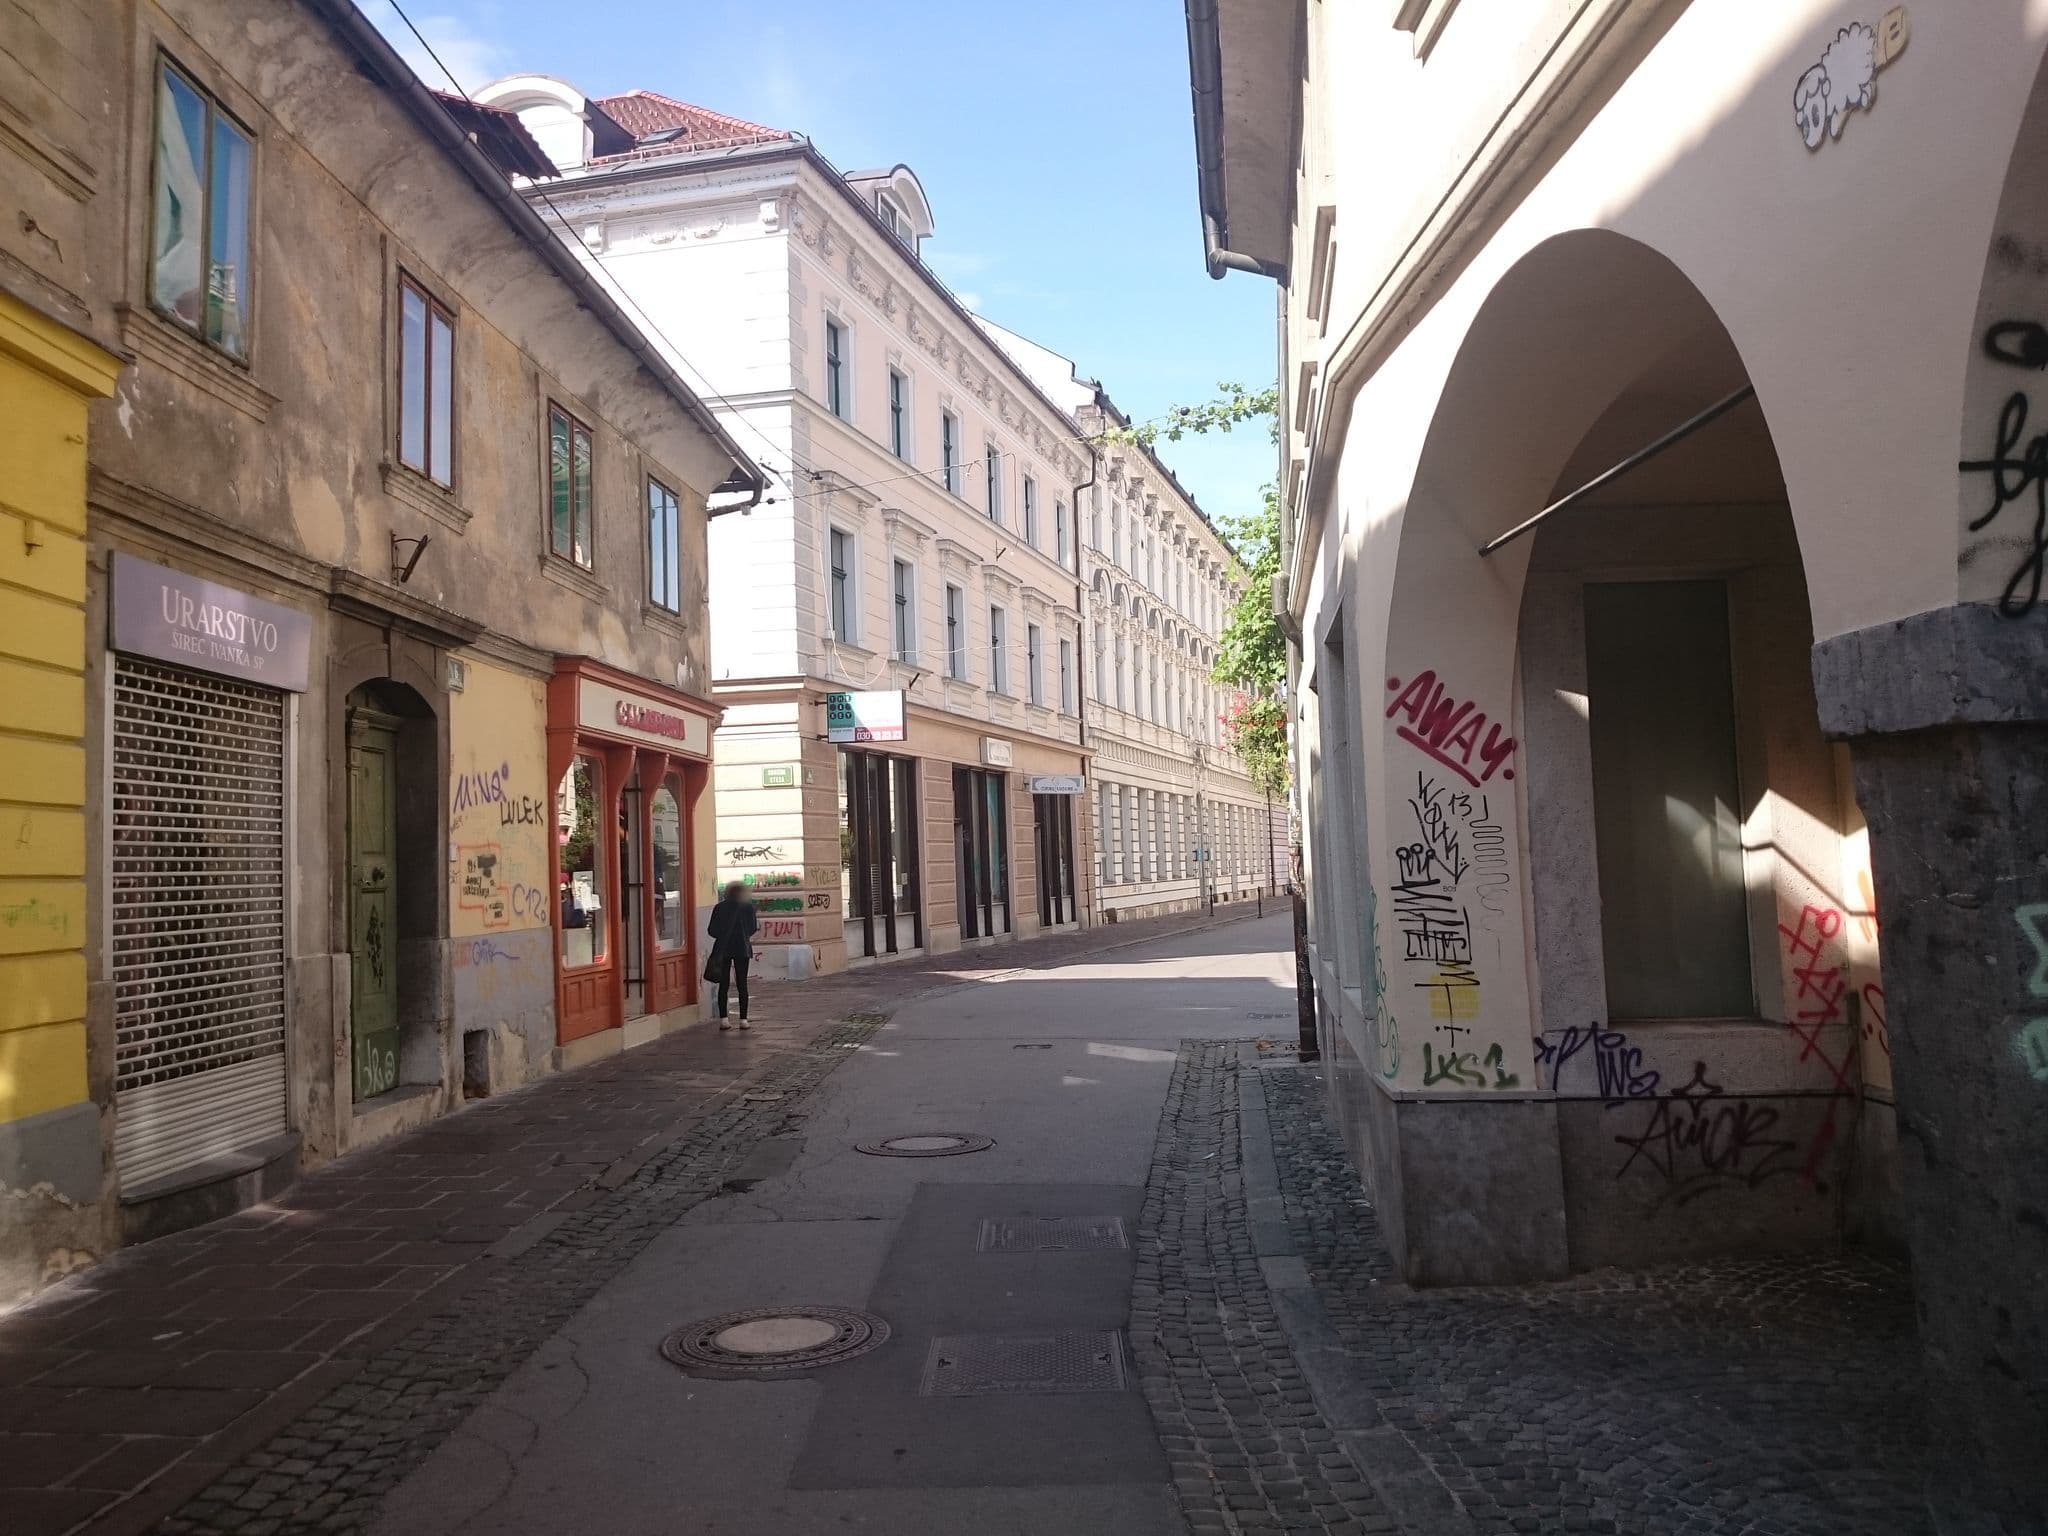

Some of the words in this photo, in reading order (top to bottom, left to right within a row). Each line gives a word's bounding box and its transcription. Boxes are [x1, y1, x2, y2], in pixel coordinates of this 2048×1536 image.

[161, 585, 278, 653] URARSTVO
[210, 641, 250, 668] IVANKA
[1386, 670, 1517, 782] AWAY
[763, 921, 804, 939] PUNT
